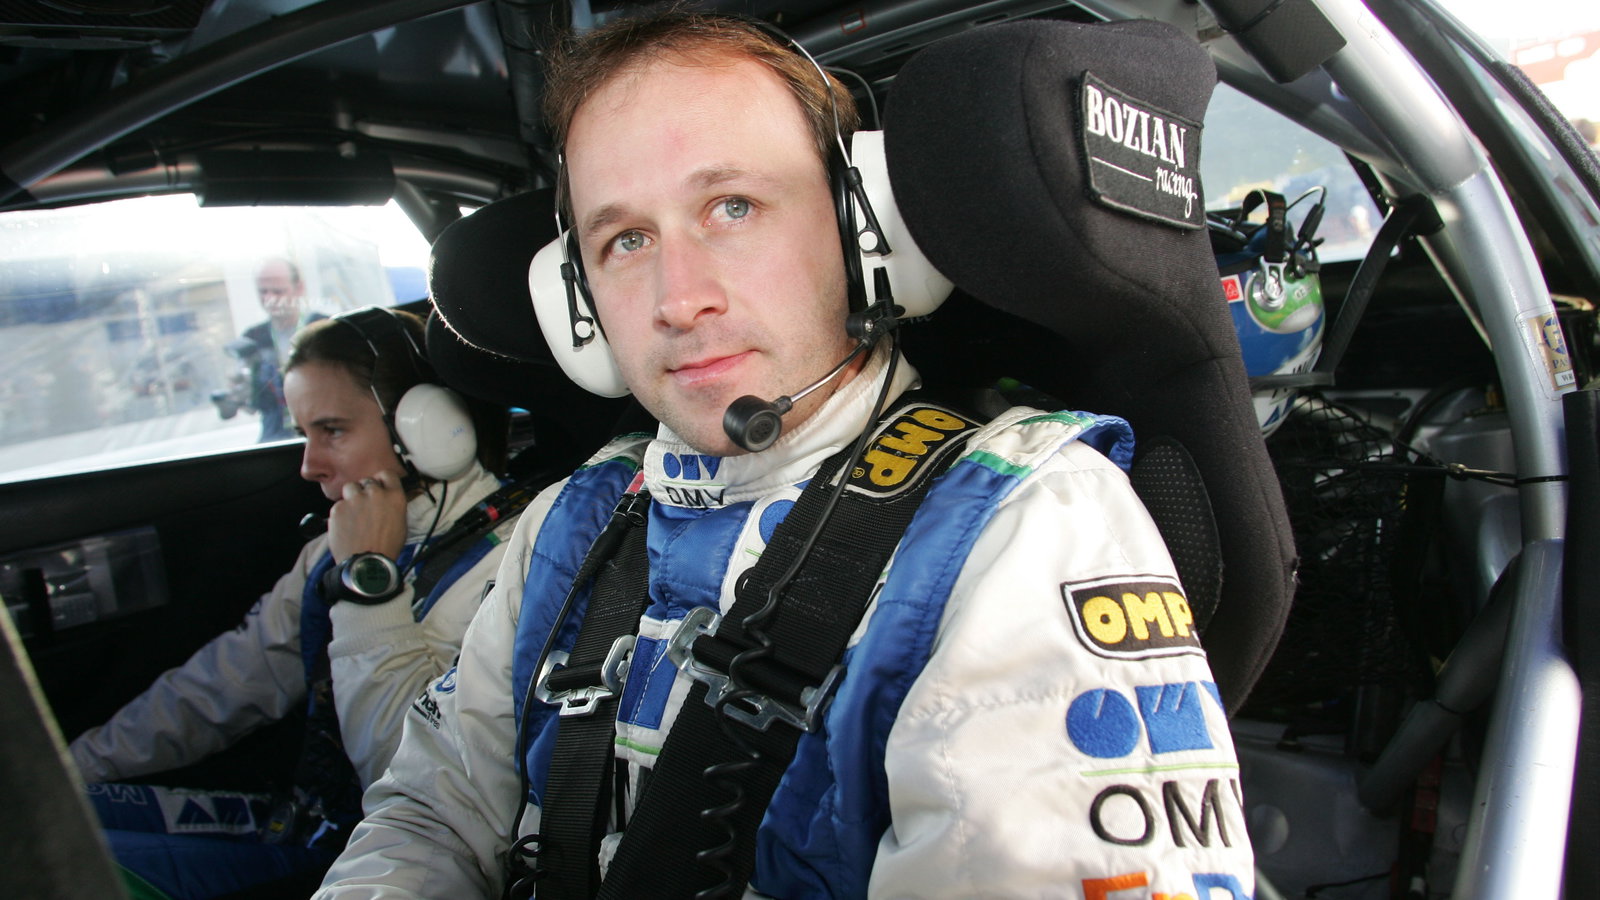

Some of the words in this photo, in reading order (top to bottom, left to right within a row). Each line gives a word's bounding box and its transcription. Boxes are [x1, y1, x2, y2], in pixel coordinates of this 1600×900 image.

[1087, 85, 1187, 168] BOZIAN
[1156, 165, 1198, 219] racing
[864, 409, 966, 487] OMP
[1082, 592, 1193, 645] OMP
